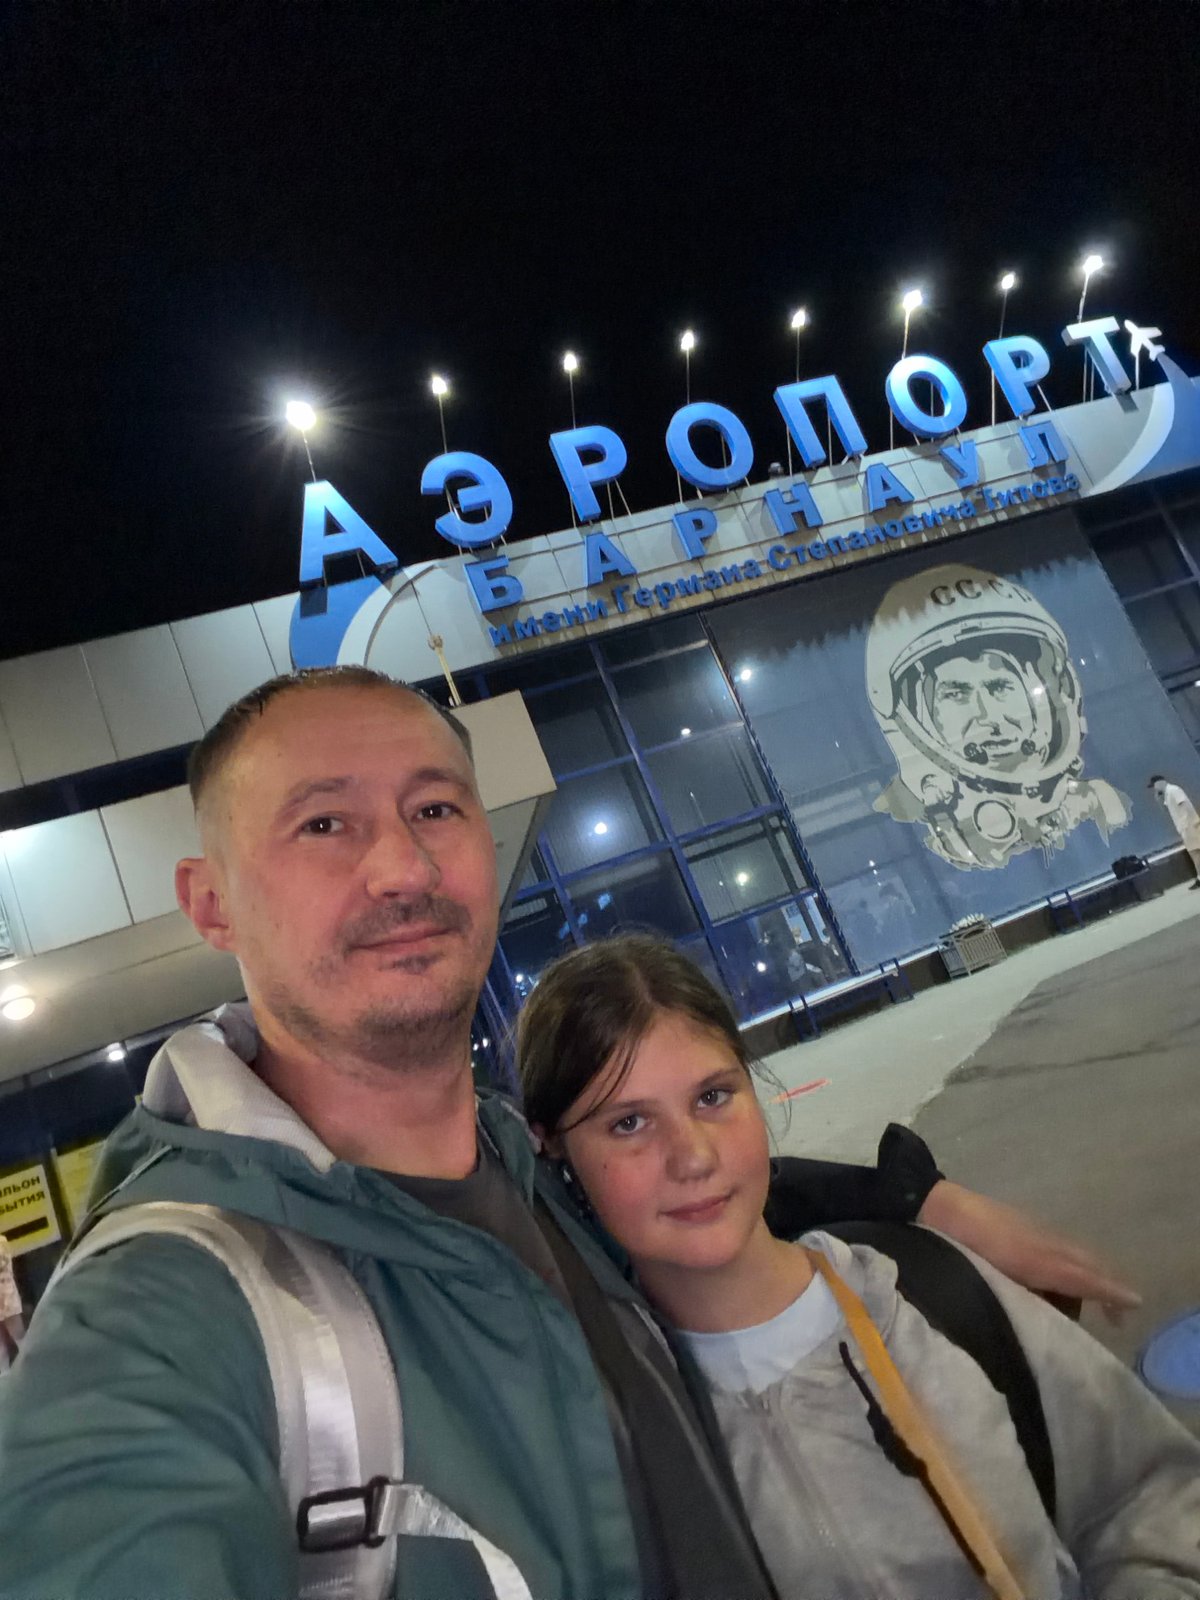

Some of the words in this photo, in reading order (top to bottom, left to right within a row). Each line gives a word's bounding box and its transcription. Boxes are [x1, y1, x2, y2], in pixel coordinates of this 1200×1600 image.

[298, 316, 1132, 583] АЭРОПОРТ
[463, 420, 1069, 613] БАРНАУЛ
[488, 597, 608, 647] имени
[612, 559, 762, 613] Германа
[768, 499, 976, 571] Степановича
[976, 473, 1081, 510] Титова
[0, 1175, 41, 1198] ЛЬОН
